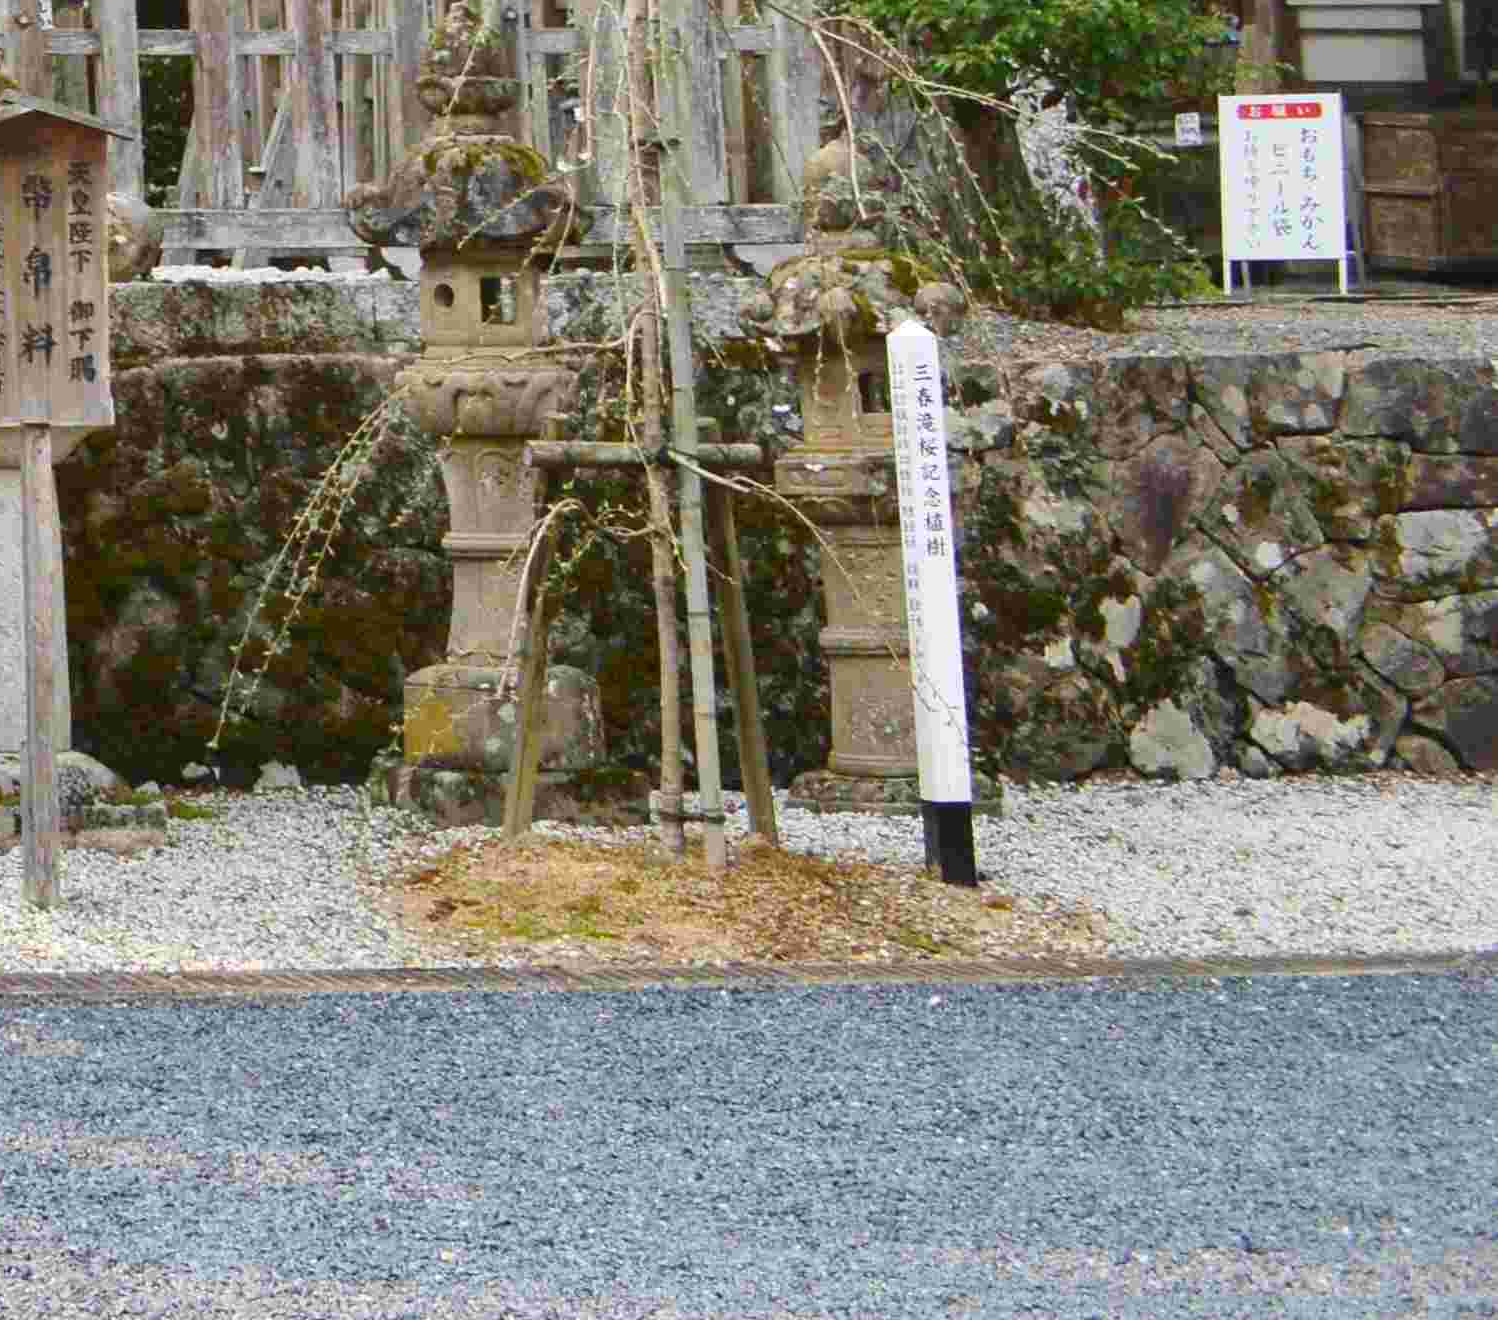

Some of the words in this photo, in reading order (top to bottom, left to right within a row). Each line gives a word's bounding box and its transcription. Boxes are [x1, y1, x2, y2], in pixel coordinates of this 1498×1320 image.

[68, 162, 93, 273] 天皇陛下
[69, 300, 96, 384] 御下賜
[913, 363, 946, 557] 三春滝桜記念植樹
